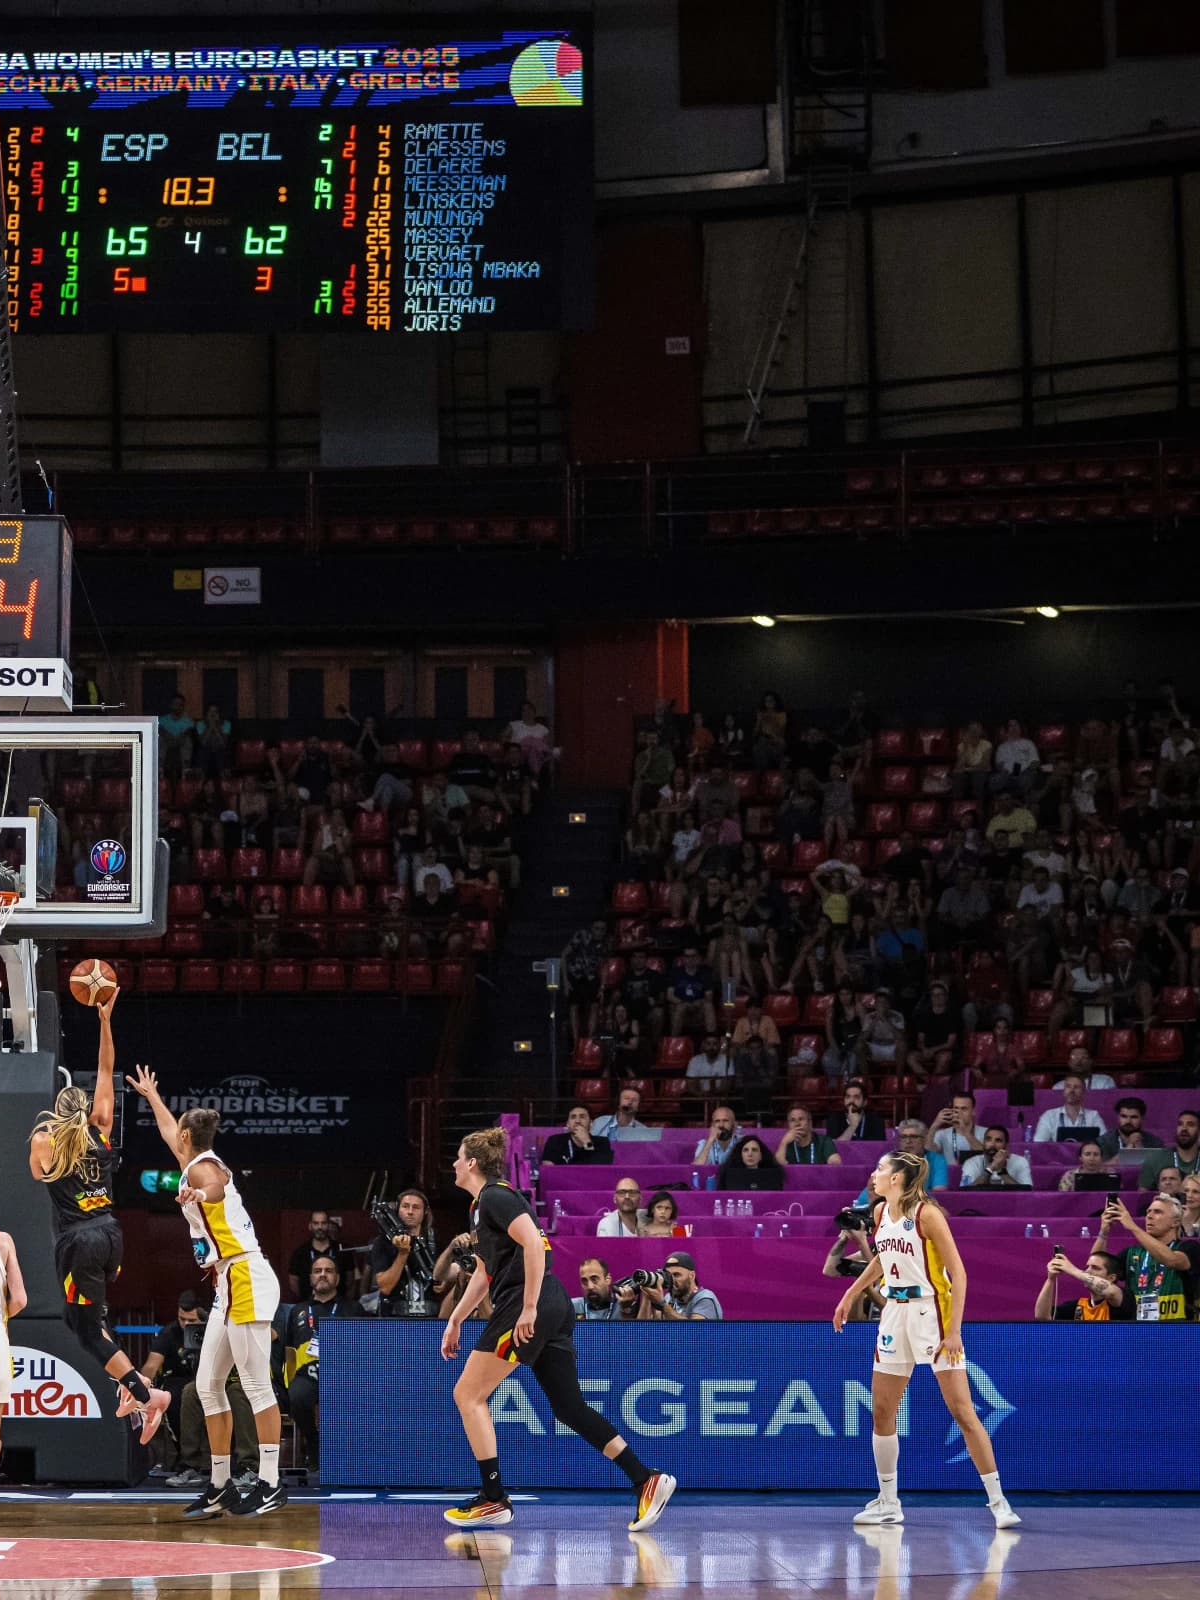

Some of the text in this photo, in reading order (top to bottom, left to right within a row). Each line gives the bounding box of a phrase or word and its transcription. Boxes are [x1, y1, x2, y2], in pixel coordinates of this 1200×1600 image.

[33, 49, 171, 69] WOMEN'S
[174, 49, 379, 69] EUROBASKET
[383, 47, 460, 67] 2025
[96, 73, 231, 92] GERMANY
[249, 73, 332, 91] ITALY
[350, 71, 460, 90] GREECE
[7, 127, 20, 143] 2
[30, 127, 44, 143] 2
[66, 127, 79, 142] 4
[319, 122, 484, 141] 2 1 4 RAMETTE
[7, 144, 20, 160] 3
[100, 133, 168, 161] ESP
[216, 132, 282, 161] BEL
[342, 140, 506, 158] 2 5 CLAESSENS
[7, 162, 20, 177] 4
[30, 161, 44, 177] 2
[66, 161, 79, 177] 3
[320, 158, 483, 175] 7 1 6 DELAERE
[7, 180, 20, 195] 6
[31, 178, 44, 195] 3
[61, 179, 79, 194] 11
[162, 177, 215, 206] 18.3
[314, 175, 507, 193] 16 1 11 MEESSEMAN
[8, 196, 20, 211] 7
[37, 197, 44, 212] 1
[66, 196, 79, 212] 3
[314, 192, 496, 210] 17 3 13 LINSKENS
[7, 213, 20, 229] 8
[342, 209, 484, 228] 2 22 MUNUNGA
[7, 231, 20, 246] 9
[60, 231, 79, 246] 11
[106, 226, 149, 255] 65
[185, 231, 201, 254] 4
[244, 225, 287, 254] 62
[366, 227, 473, 244] 25 MASSEY
[31, 247, 43, 264] 3
[66, 247, 79, 263] 9
[366, 244, 484, 261] 27 VERVAET
[7, 265, 19, 281] 3
[66, 265, 79, 281] 3
[255, 266, 272, 291] 3
[349, 261, 540, 279] 1 31 LISOWA MBAKA
[113, 266, 131, 292] 5
[7, 283, 19, 298] 4
[30, 282, 43, 298] 2
[60, 282, 78, 298] 10
[319, 279, 473, 297] 3 2 35 VANLOO
[7, 300, 19, 316] 0
[30, 300, 43, 316] 2
[60, 301, 78, 316] 11
[314, 297, 496, 314] 17 2 55 ALLEMAND
[7, 318, 19, 333] 4
[366, 314, 462, 332] 99 JORIS
[87, 883, 130, 892] EUROBASKET
[189, 1087, 299, 1096] WOMEN'S
[234, 1126, 324, 1135] GREECE
[245, 1119, 350, 1127] GERMANY
[877, 1237, 915, 1257] ESPAÑA
[890, 1263, 900, 1279] 4
